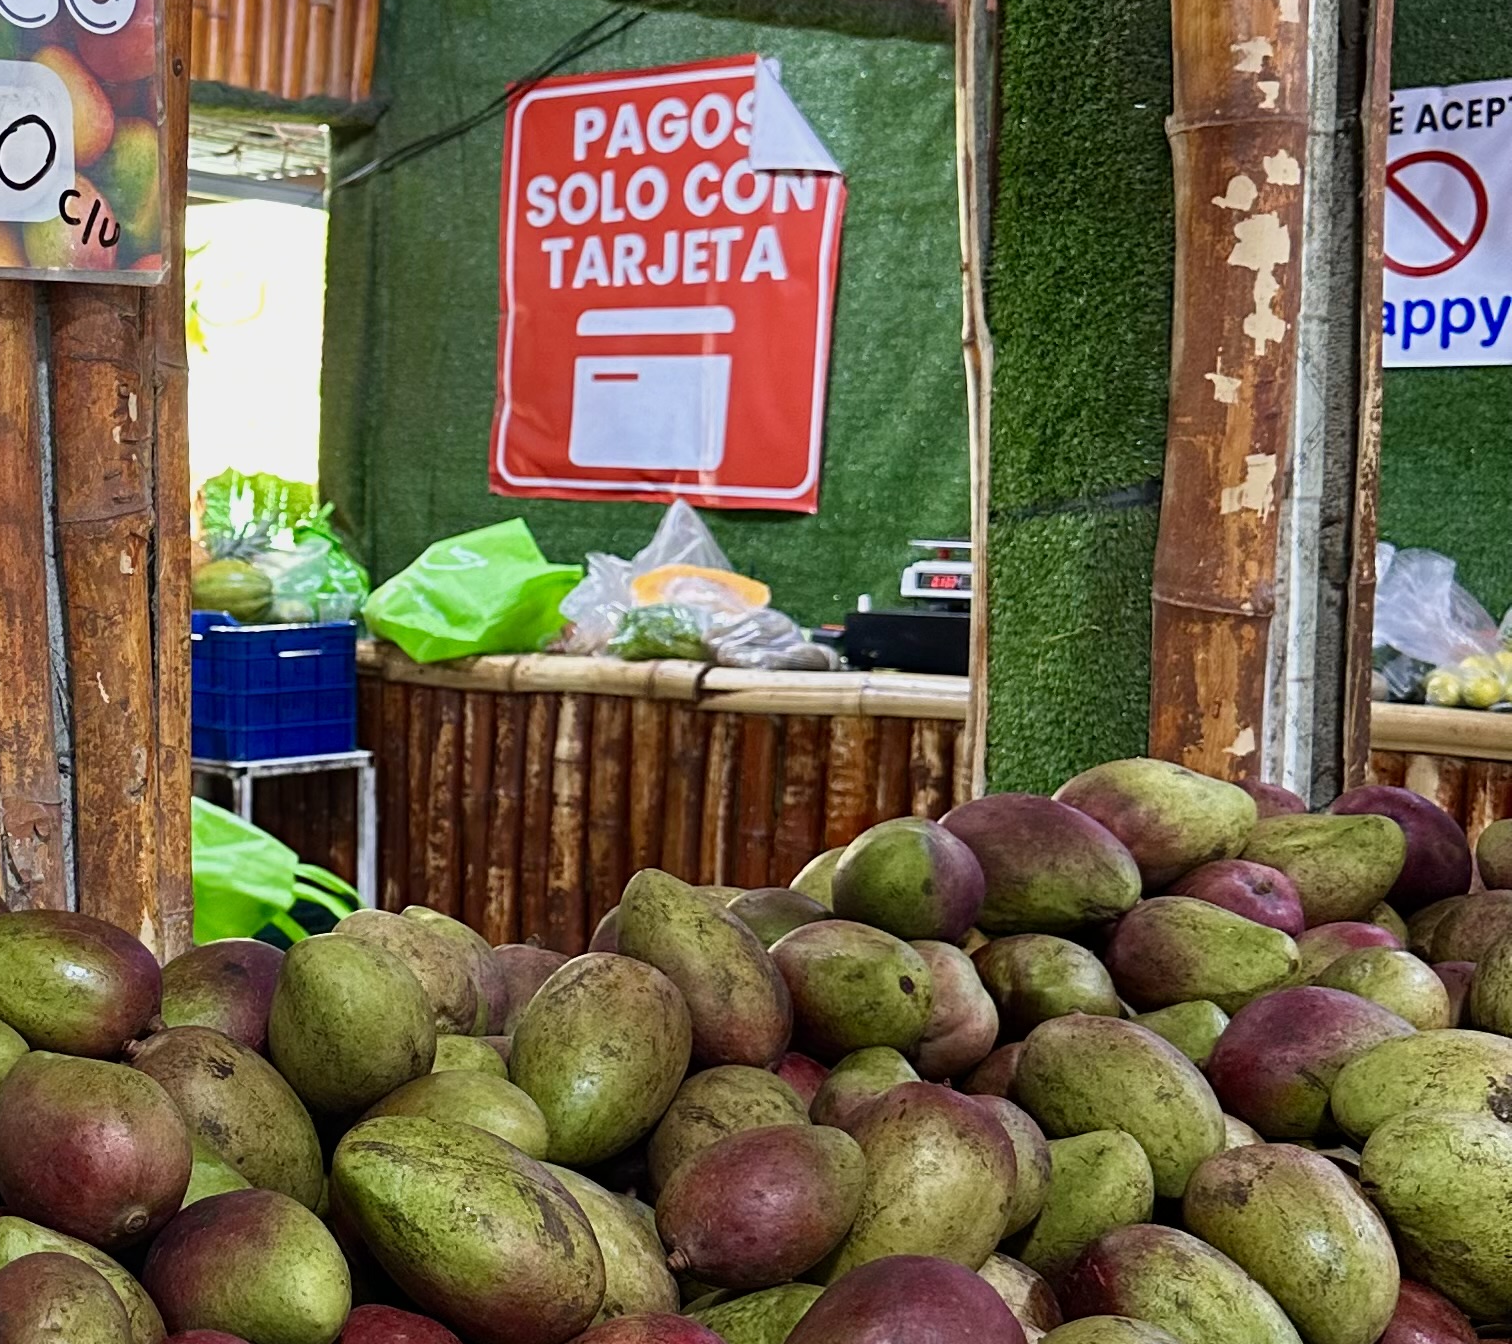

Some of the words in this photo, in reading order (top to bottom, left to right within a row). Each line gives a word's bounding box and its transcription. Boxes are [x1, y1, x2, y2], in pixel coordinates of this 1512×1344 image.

[574, 91, 755, 161] PAGOS
[1415, 96, 1512, 134] ACEP
[526, 167, 668, 227] SOLO
[683, 160, 815, 217] CON
[541, 226, 787, 289] TARJETA
